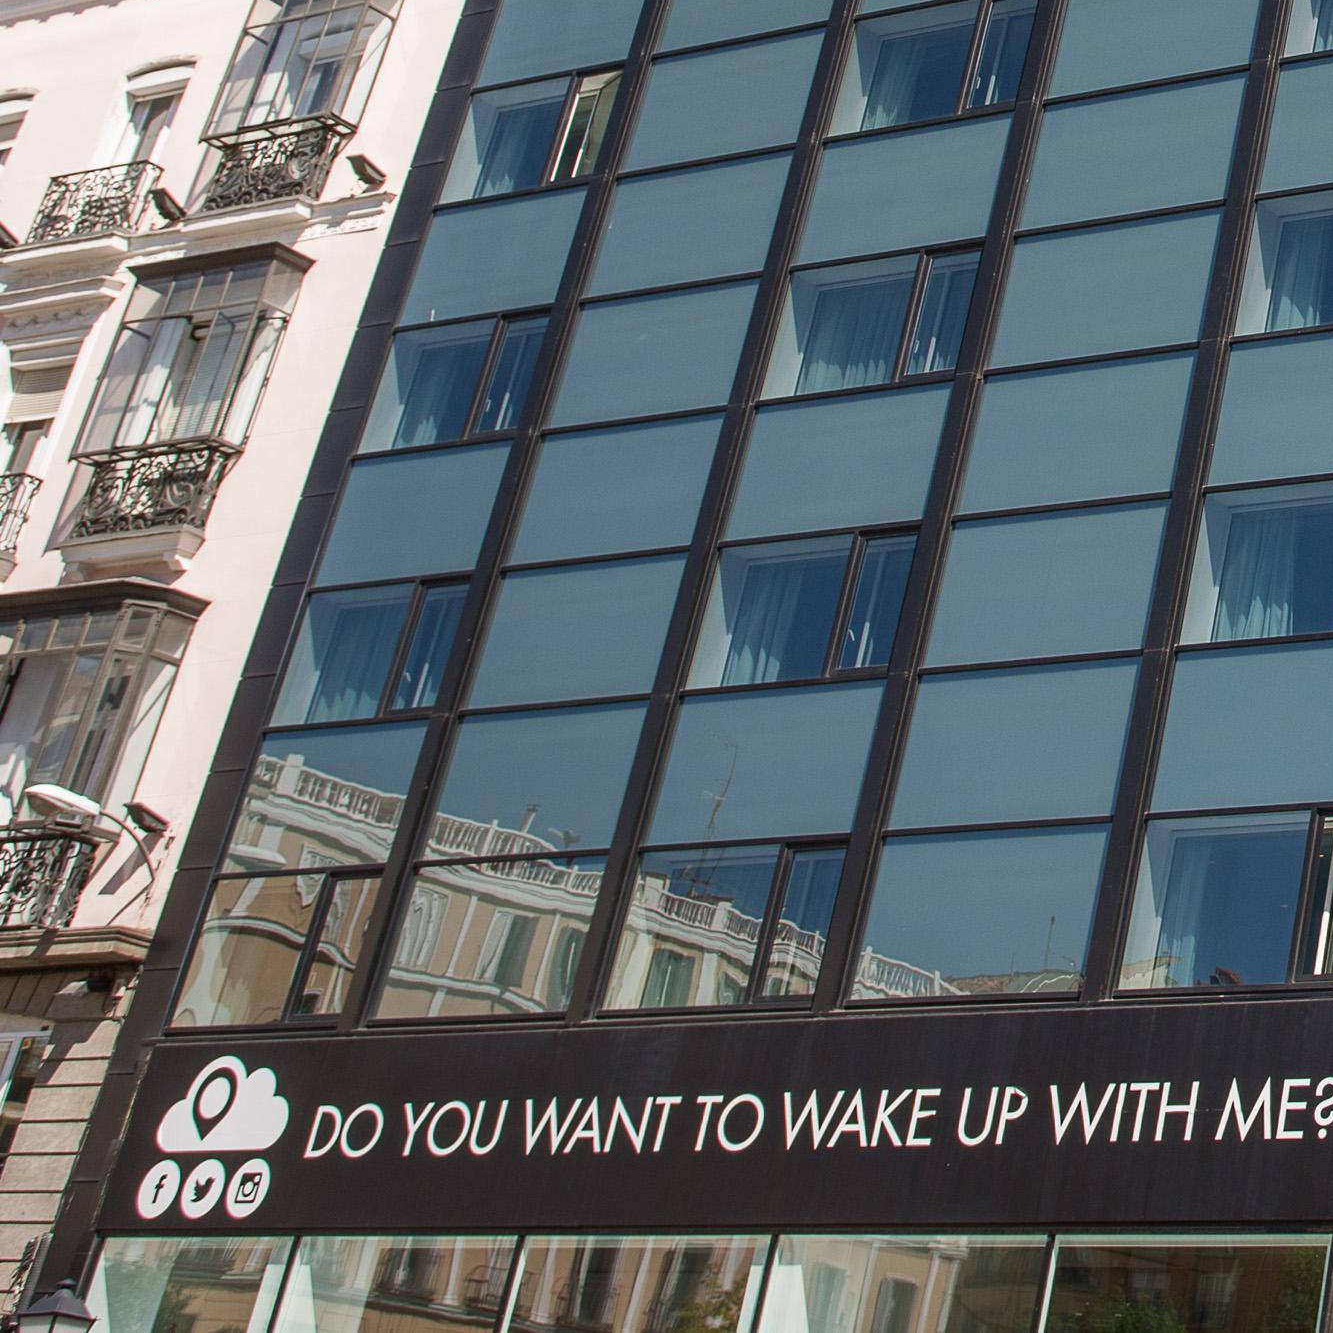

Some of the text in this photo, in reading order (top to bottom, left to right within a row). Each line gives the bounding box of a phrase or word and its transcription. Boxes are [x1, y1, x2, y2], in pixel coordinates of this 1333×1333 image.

[303, 1103, 385, 1159] DO
[402, 1099, 509, 1158] YOU
[524, 1095, 682, 1156] WANT
[694, 1093, 765, 1152] TO
[784, 1087, 942, 1150] WAKE
[957, 1086, 1029, 1146] UP
[1049, 1080, 1200, 1146] WITH
